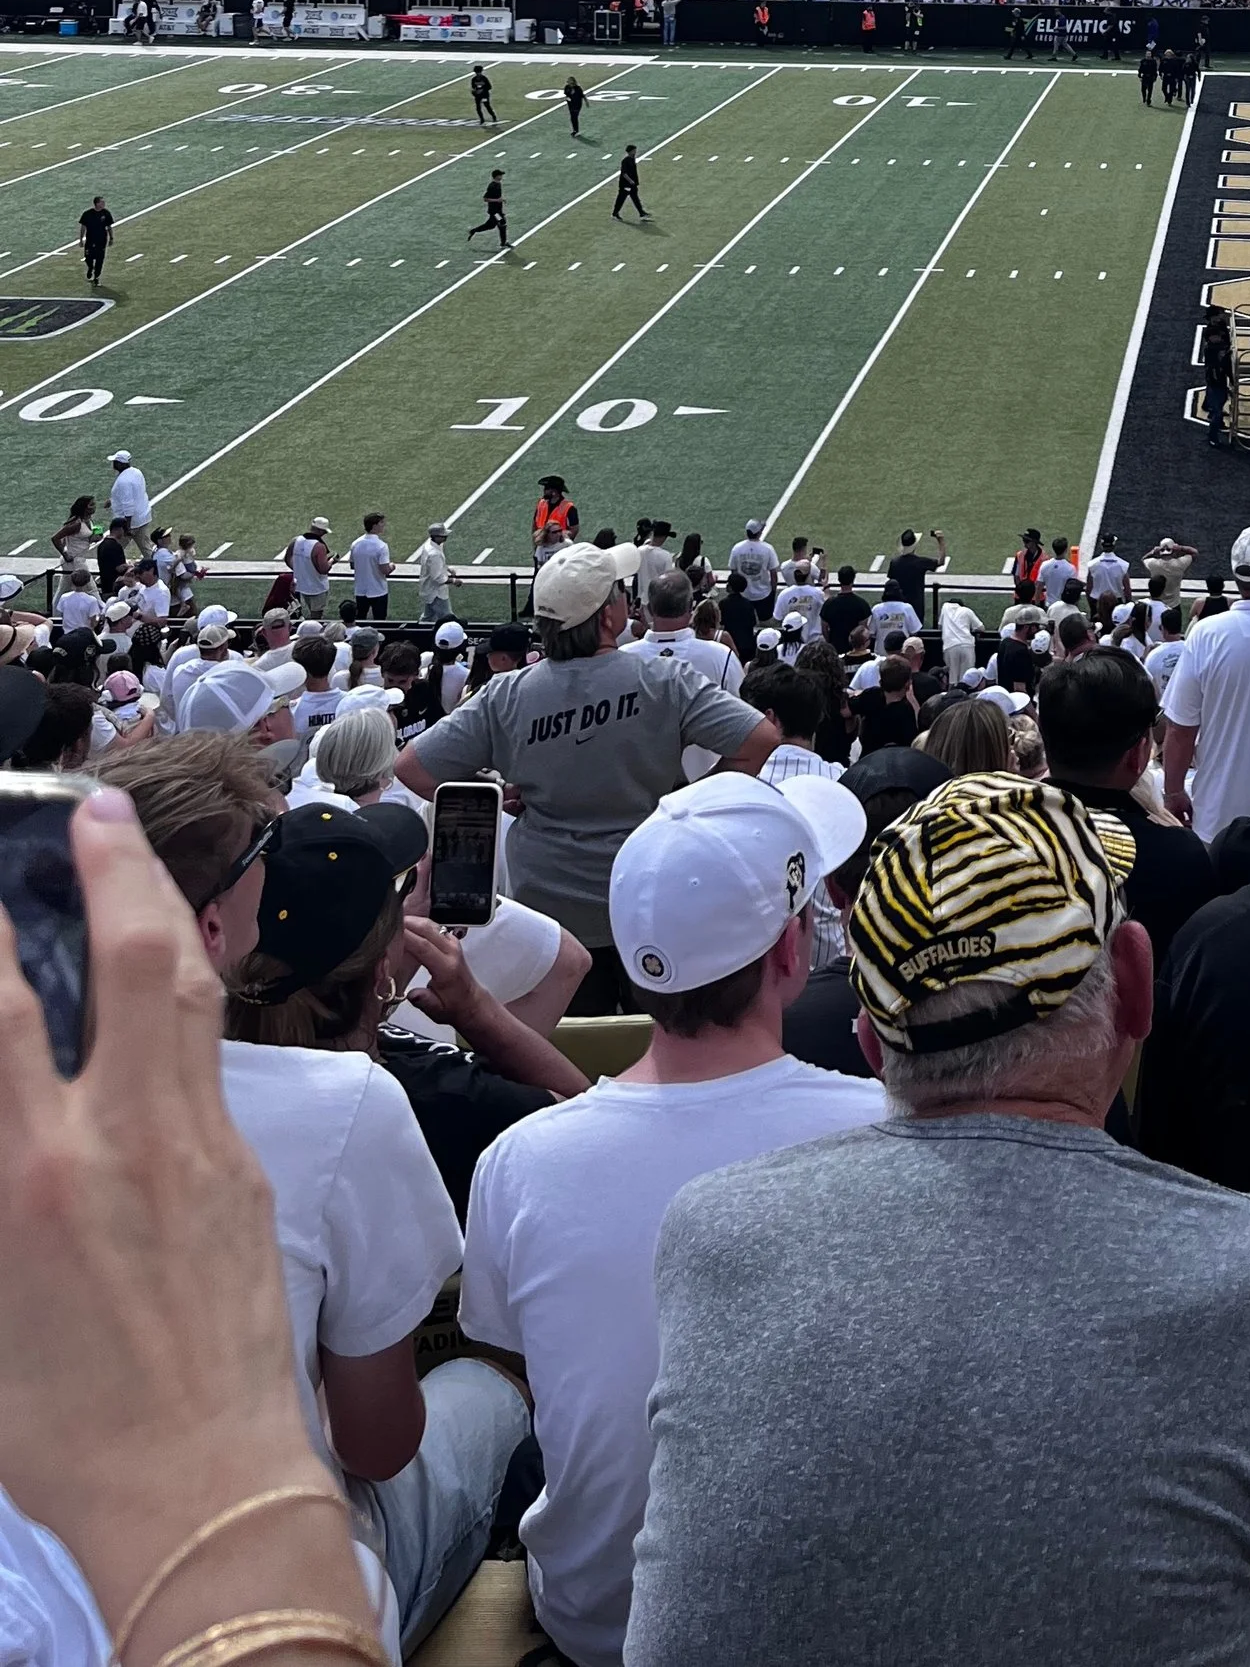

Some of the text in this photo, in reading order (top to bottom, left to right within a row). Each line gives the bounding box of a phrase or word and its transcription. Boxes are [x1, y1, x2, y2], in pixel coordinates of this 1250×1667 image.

[1037, 18, 1132, 34] ELVATIOS
[527, 691, 640, 746] JUST DO IT.
[898, 935, 992, 983] BUFFALOES
